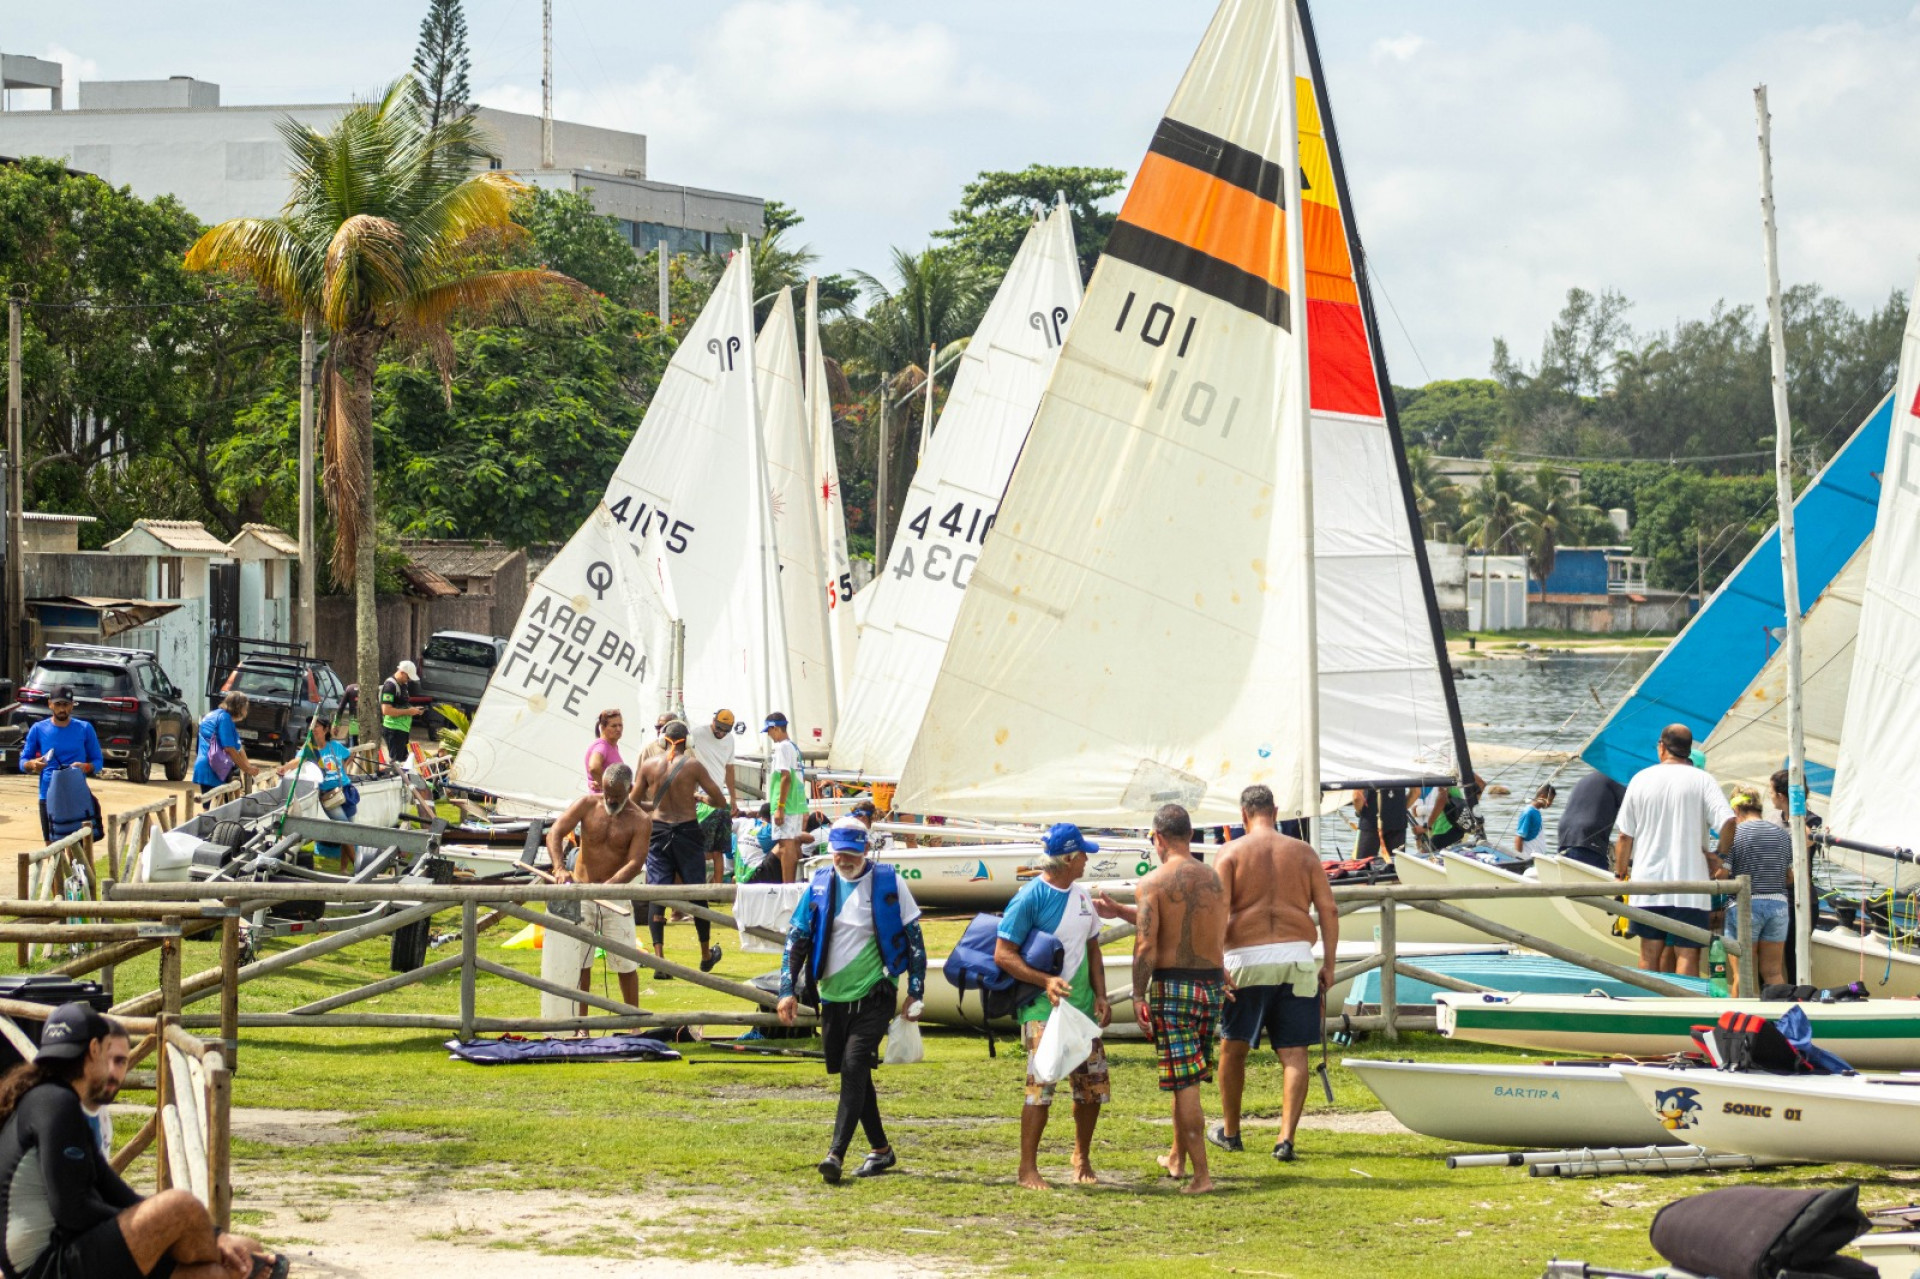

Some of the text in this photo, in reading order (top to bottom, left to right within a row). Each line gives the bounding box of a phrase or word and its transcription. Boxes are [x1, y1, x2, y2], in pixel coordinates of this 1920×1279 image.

[1114, 291, 1197, 359] 101
[610, 495, 695, 554] 4105
[596, 630, 647, 684] BRA
[1722, 1102, 1772, 1118] SONIC
